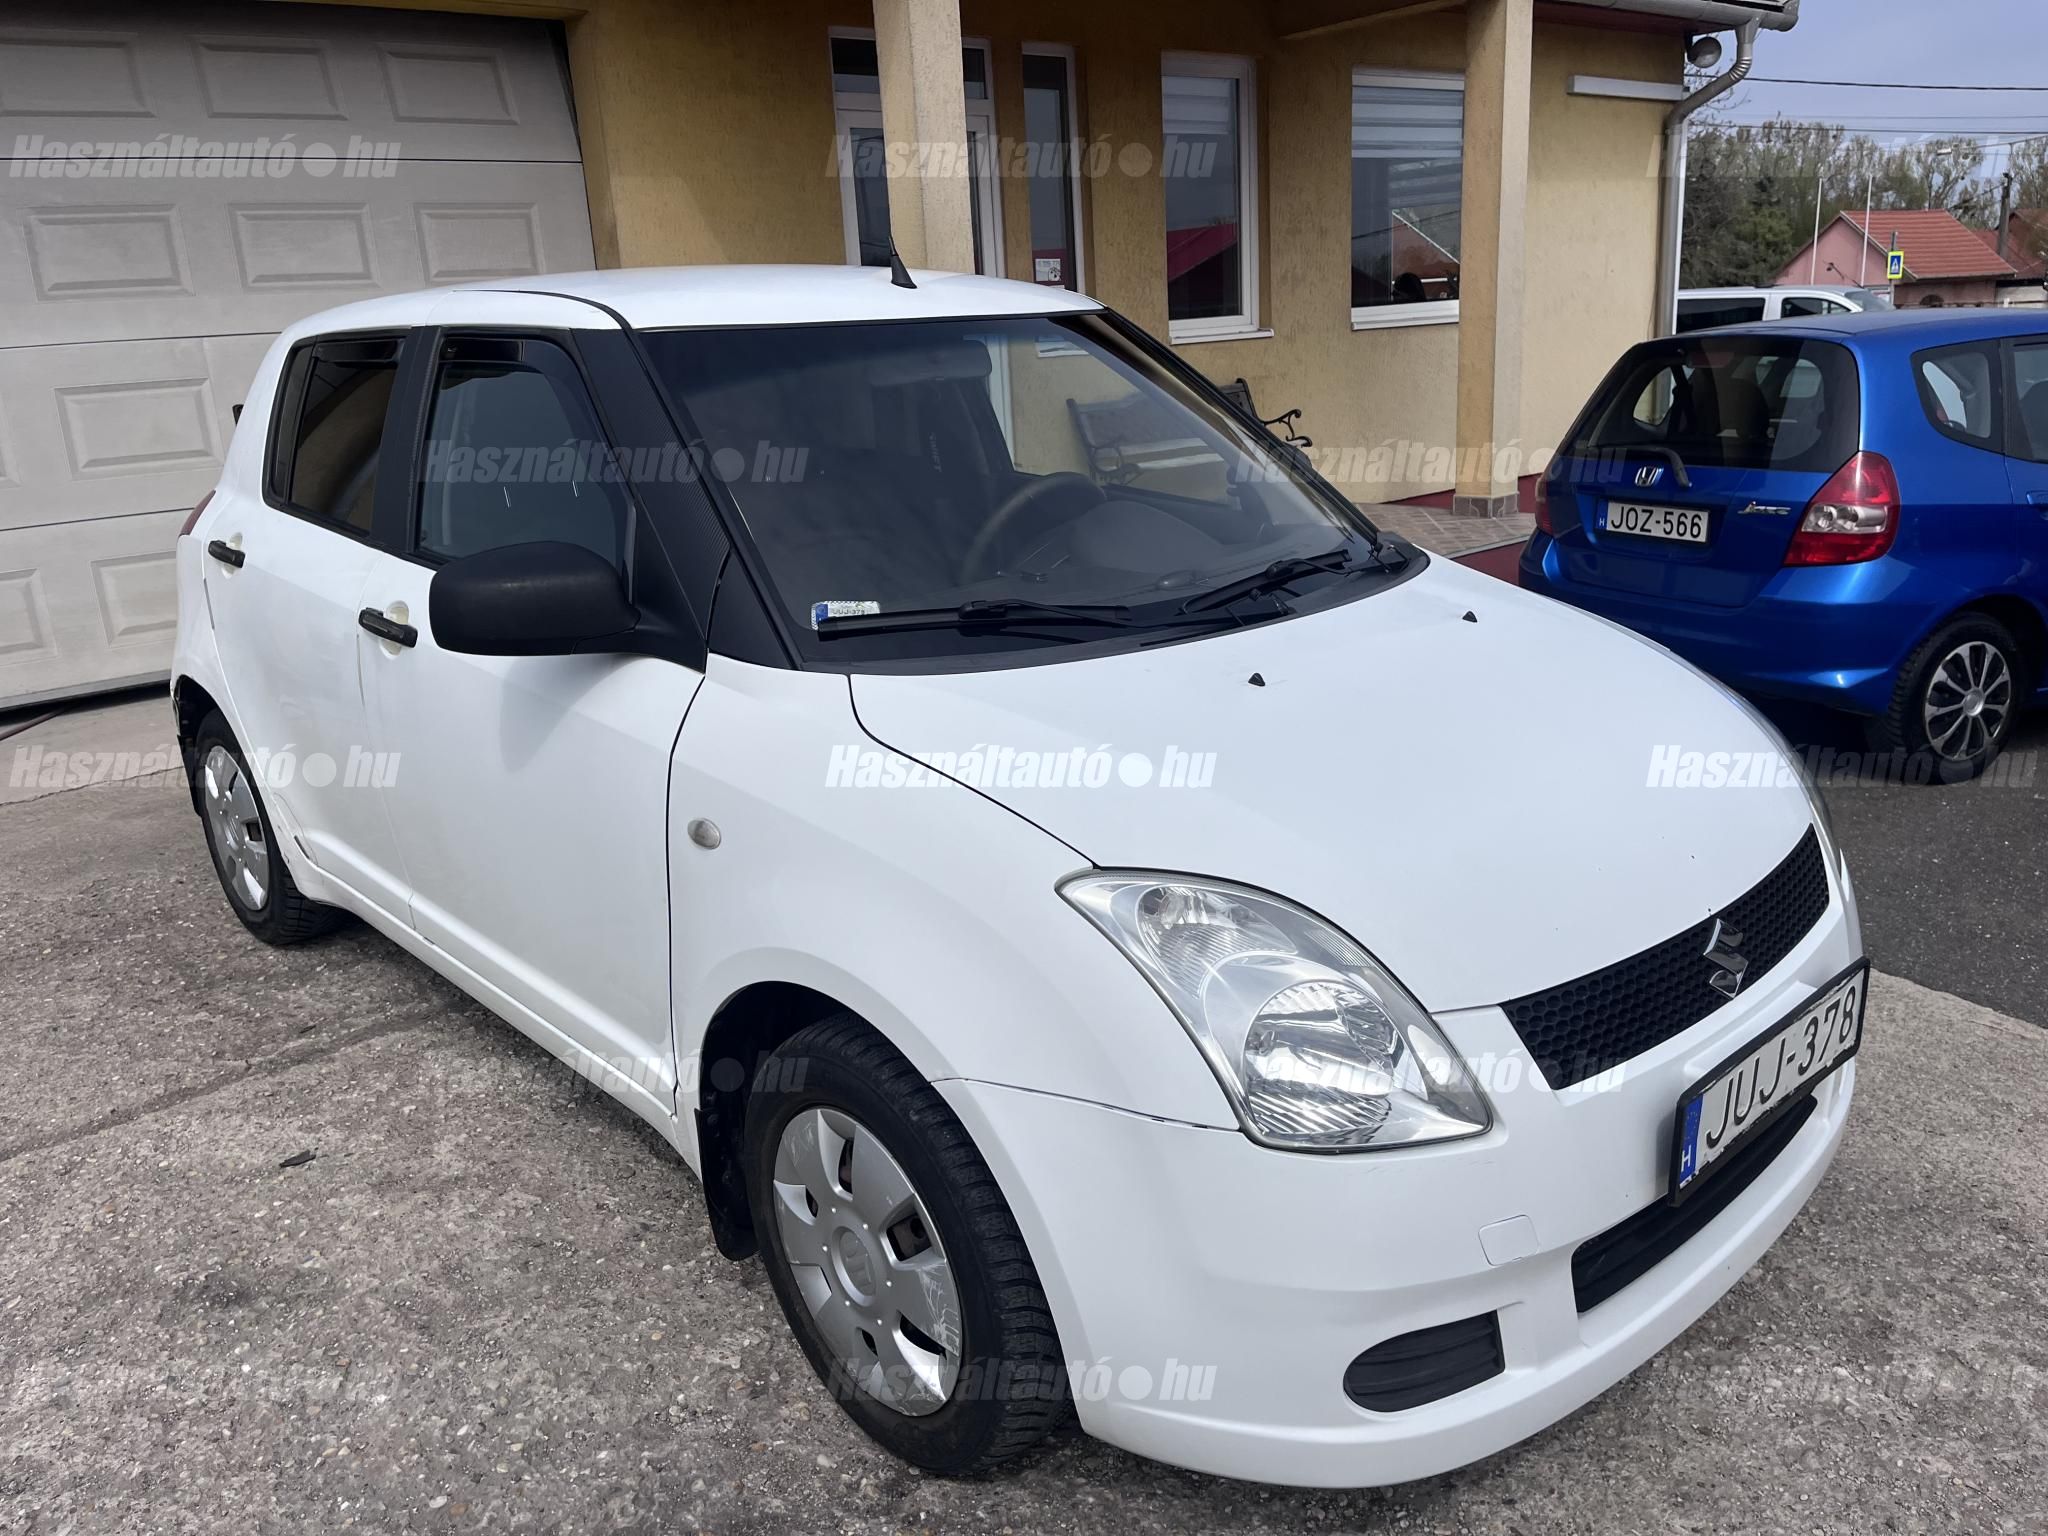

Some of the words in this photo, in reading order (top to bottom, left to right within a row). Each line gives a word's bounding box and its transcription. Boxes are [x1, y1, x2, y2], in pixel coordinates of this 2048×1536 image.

[1611, 506, 1703, 539] JOZ-566
[1680, 1144, 1692, 1173] H
[1705, 986, 1856, 1149] JUJ-378
